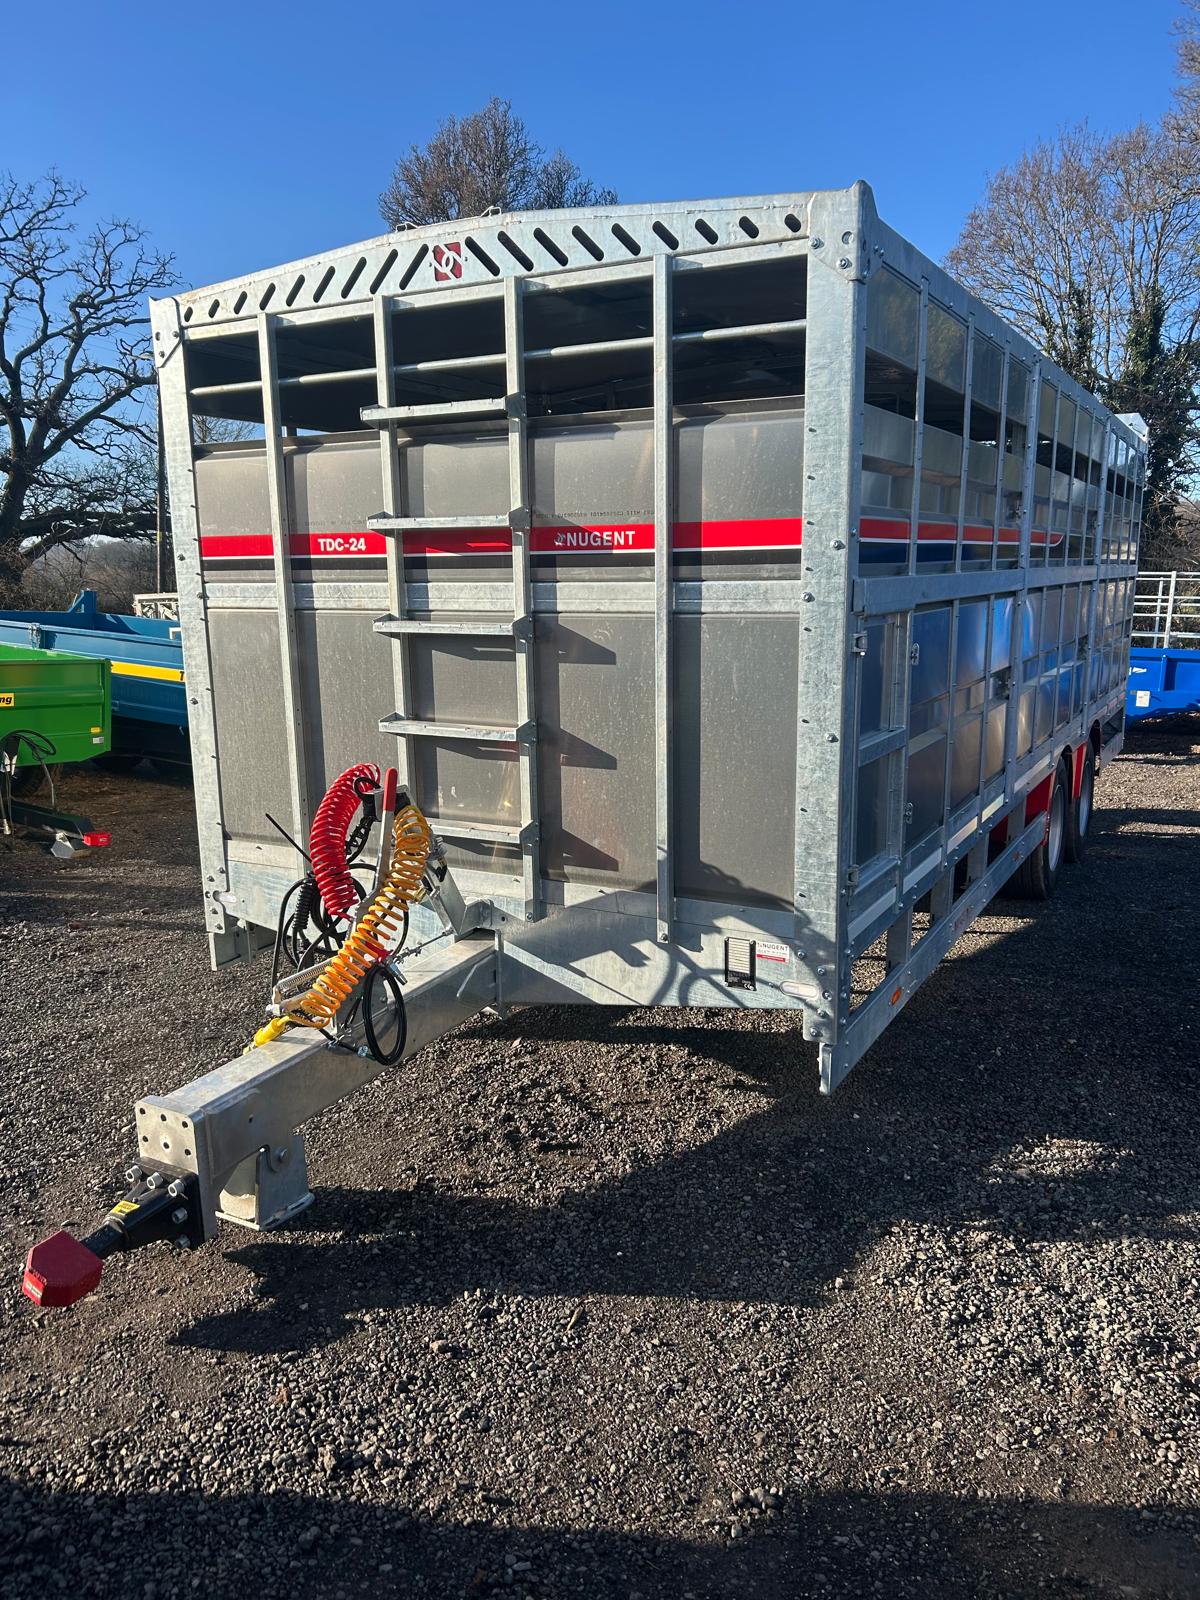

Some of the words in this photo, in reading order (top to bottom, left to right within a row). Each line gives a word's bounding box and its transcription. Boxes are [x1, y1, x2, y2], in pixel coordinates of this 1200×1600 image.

[317, 537, 367, 552] TDC-24
[567, 530, 636, 547] NUGENT
[762, 943, 788, 952] NUGENT
